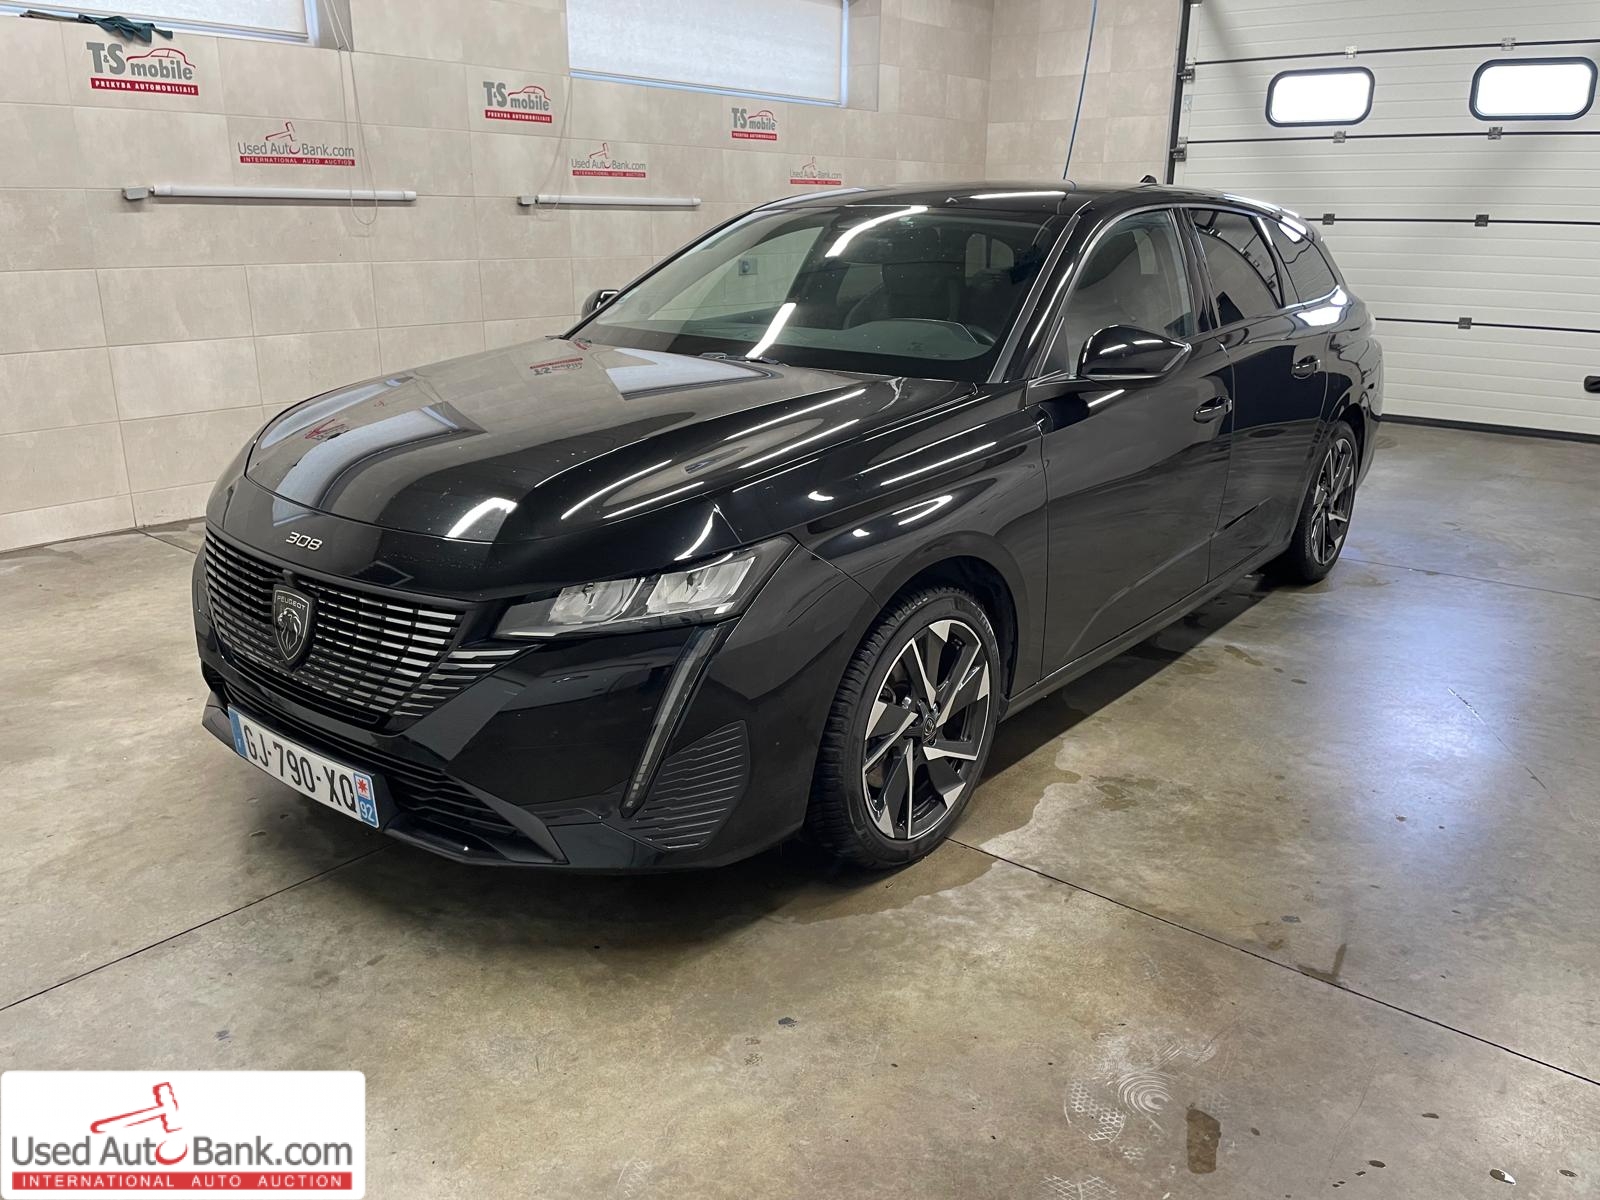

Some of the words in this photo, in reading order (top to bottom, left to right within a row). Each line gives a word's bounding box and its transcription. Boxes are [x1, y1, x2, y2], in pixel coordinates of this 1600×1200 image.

[130, 59, 193, 80] mobile
[95, 80, 131, 89] PREKYBA
[135, 82, 195, 94] AUTOMOBILIAIS
[510, 95, 550, 111] mobile
[731, 108, 747, 129] TS
[749, 117, 776, 131] mobile
[238, 142, 267, 155] Used
[270, 142, 300, 155] Auto
[302, 143, 355, 157] Bank.com
[571, 159, 590, 168] Used
[612, 160, 646, 170] Bank.com
[285, 531, 323, 551] 308
[277, 595, 306, 611] PEUGEOT
[243, 724, 358, 814] GJ-790-XQ
[359, 800, 376, 823] 92
